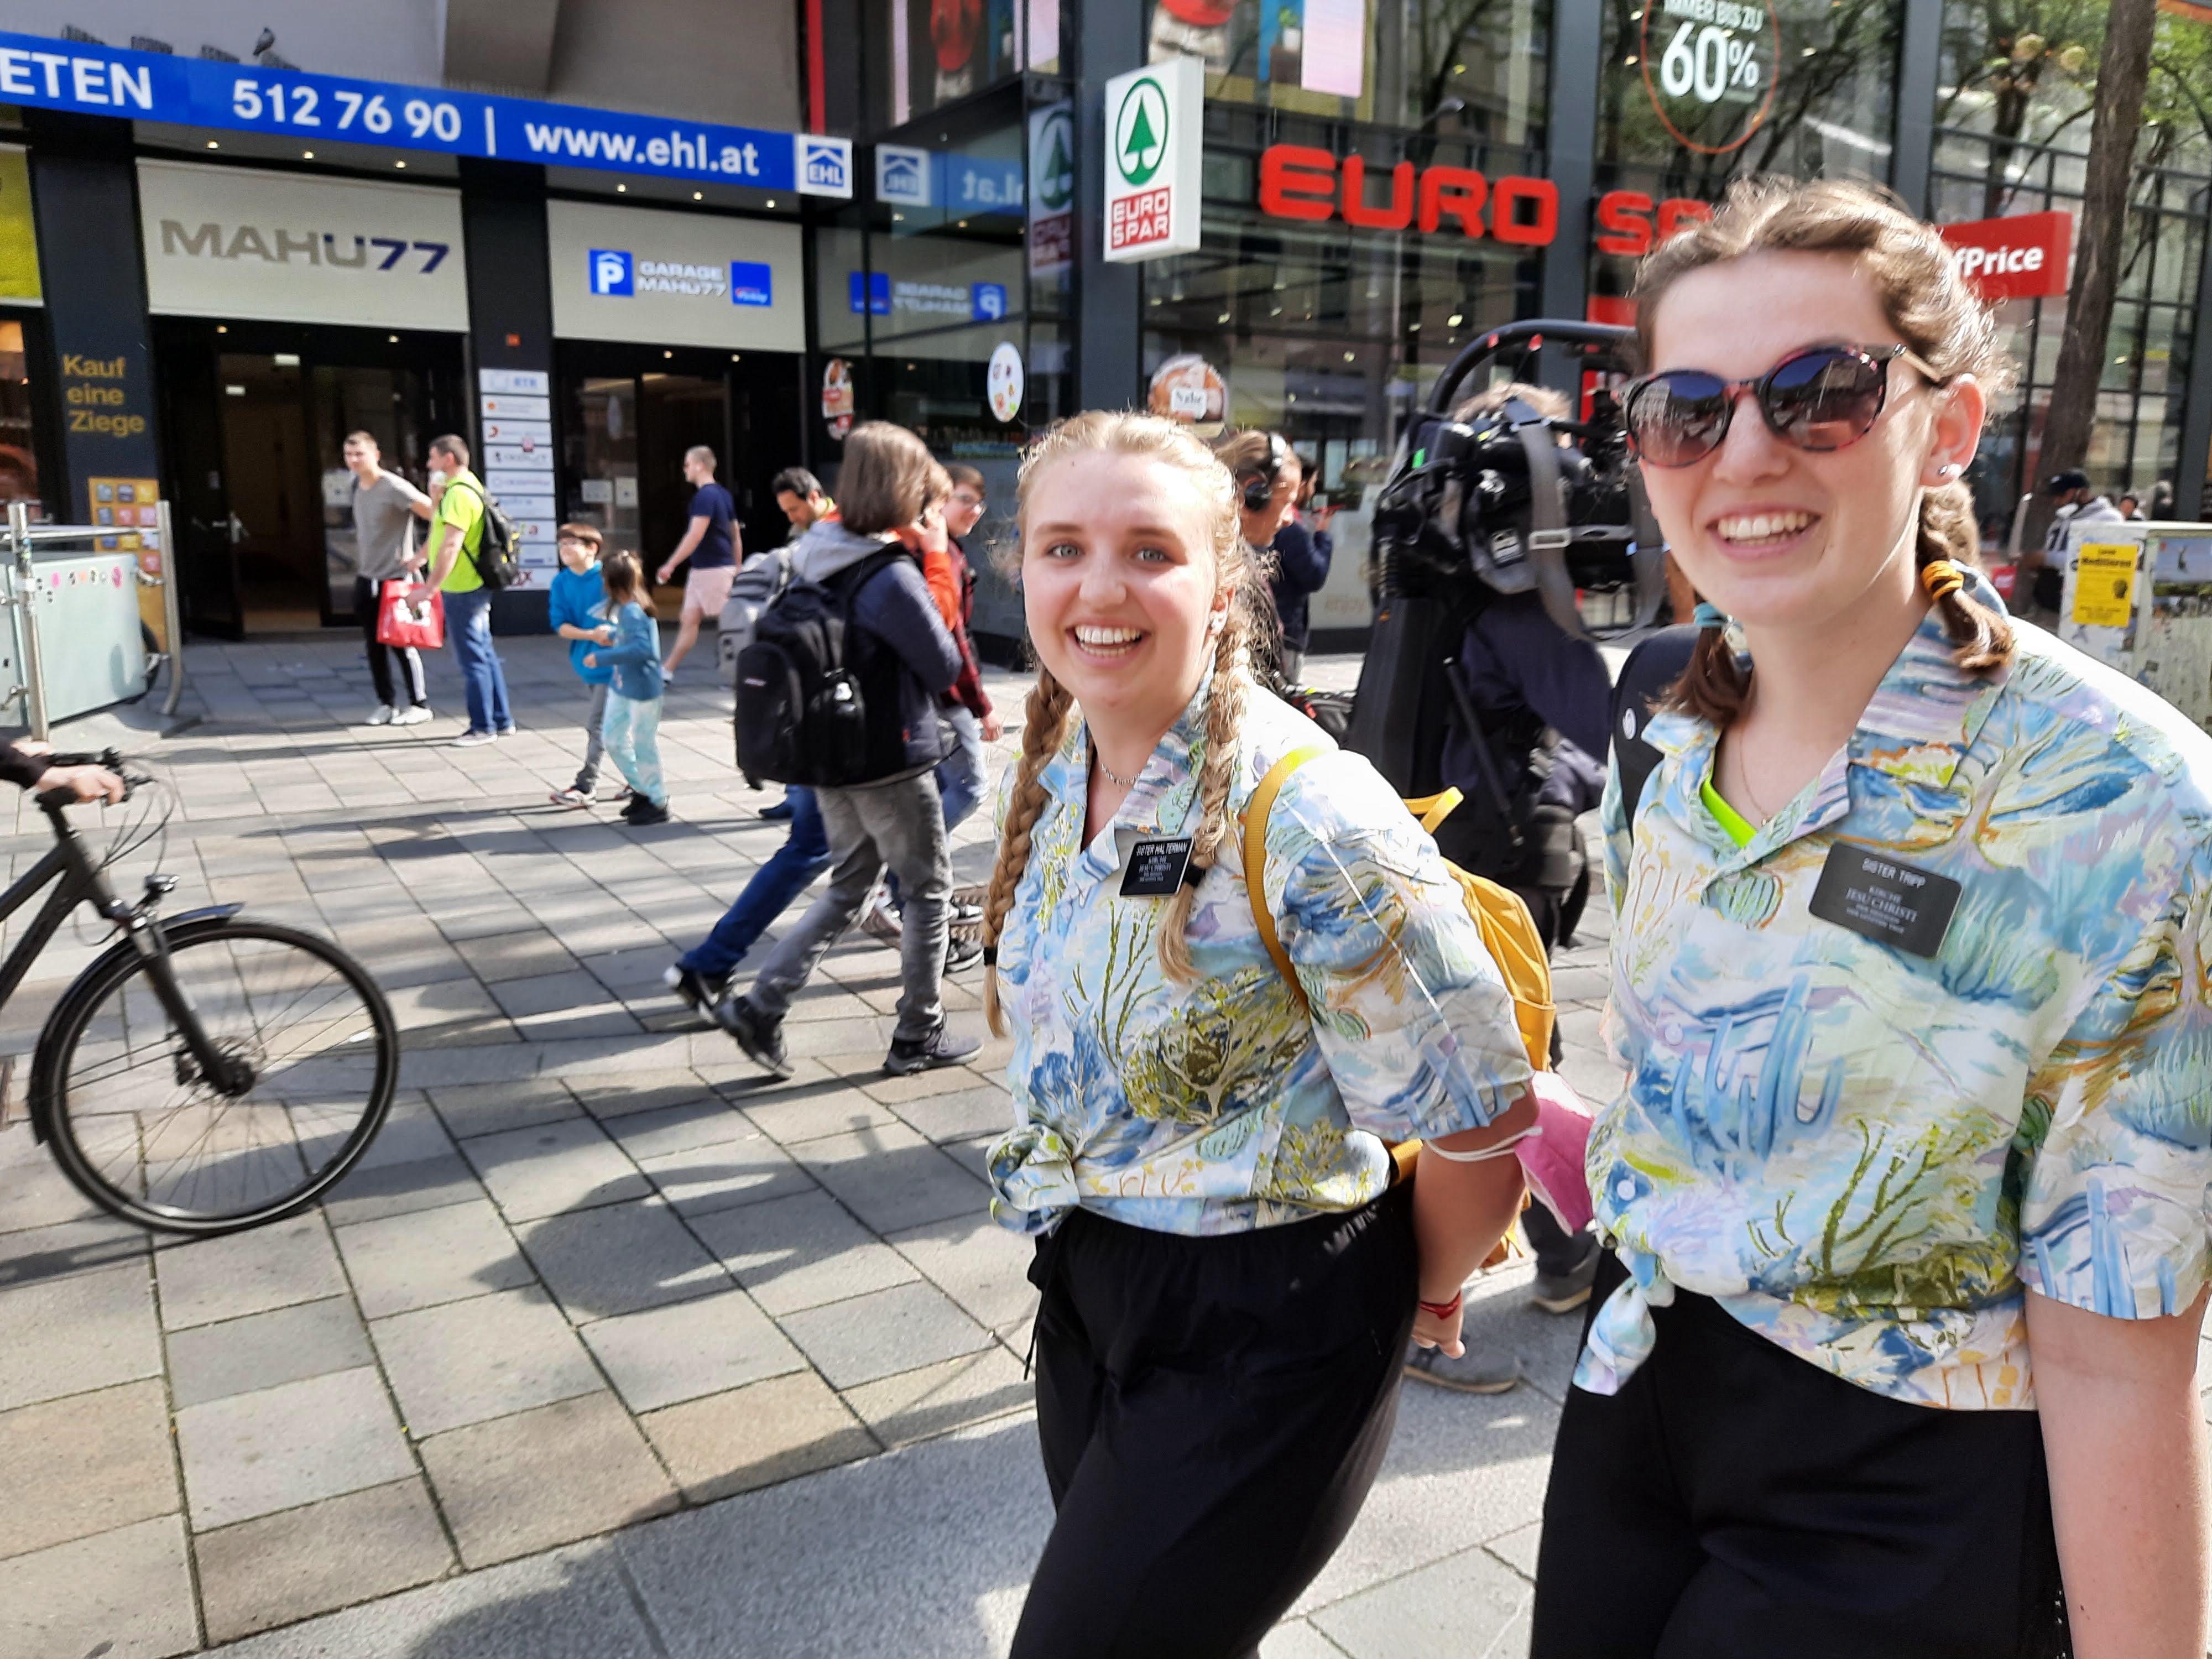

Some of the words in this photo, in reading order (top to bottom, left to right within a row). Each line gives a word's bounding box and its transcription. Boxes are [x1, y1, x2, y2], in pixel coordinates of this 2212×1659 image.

[1716, 2, 1741, 28] BIS
[1741, 6, 1765, 33] ZU
[1661, 20, 1761, 103] 60%
[233, 79, 321, 127] 512
[334, 90, 393, 134] 76
[404, 100, 462, 142] 90
[524, 123, 760, 176] www.ehl.at
[808, 164, 844, 185] EHL
[1113, 191, 1169, 224] EURO
[1260, 144, 1559, 246] EURO
[1113, 213, 1168, 246] SPAR
[160, 219, 451, 274] MAHU77
[597, 261, 625, 294] P
[639, 260, 724, 280] GARAGE
[636, 276, 727, 297] MAHU77
[62, 354, 126, 378] Kauf
[66, 383, 124, 405] eine
[69, 410, 145, 437] Ziege
